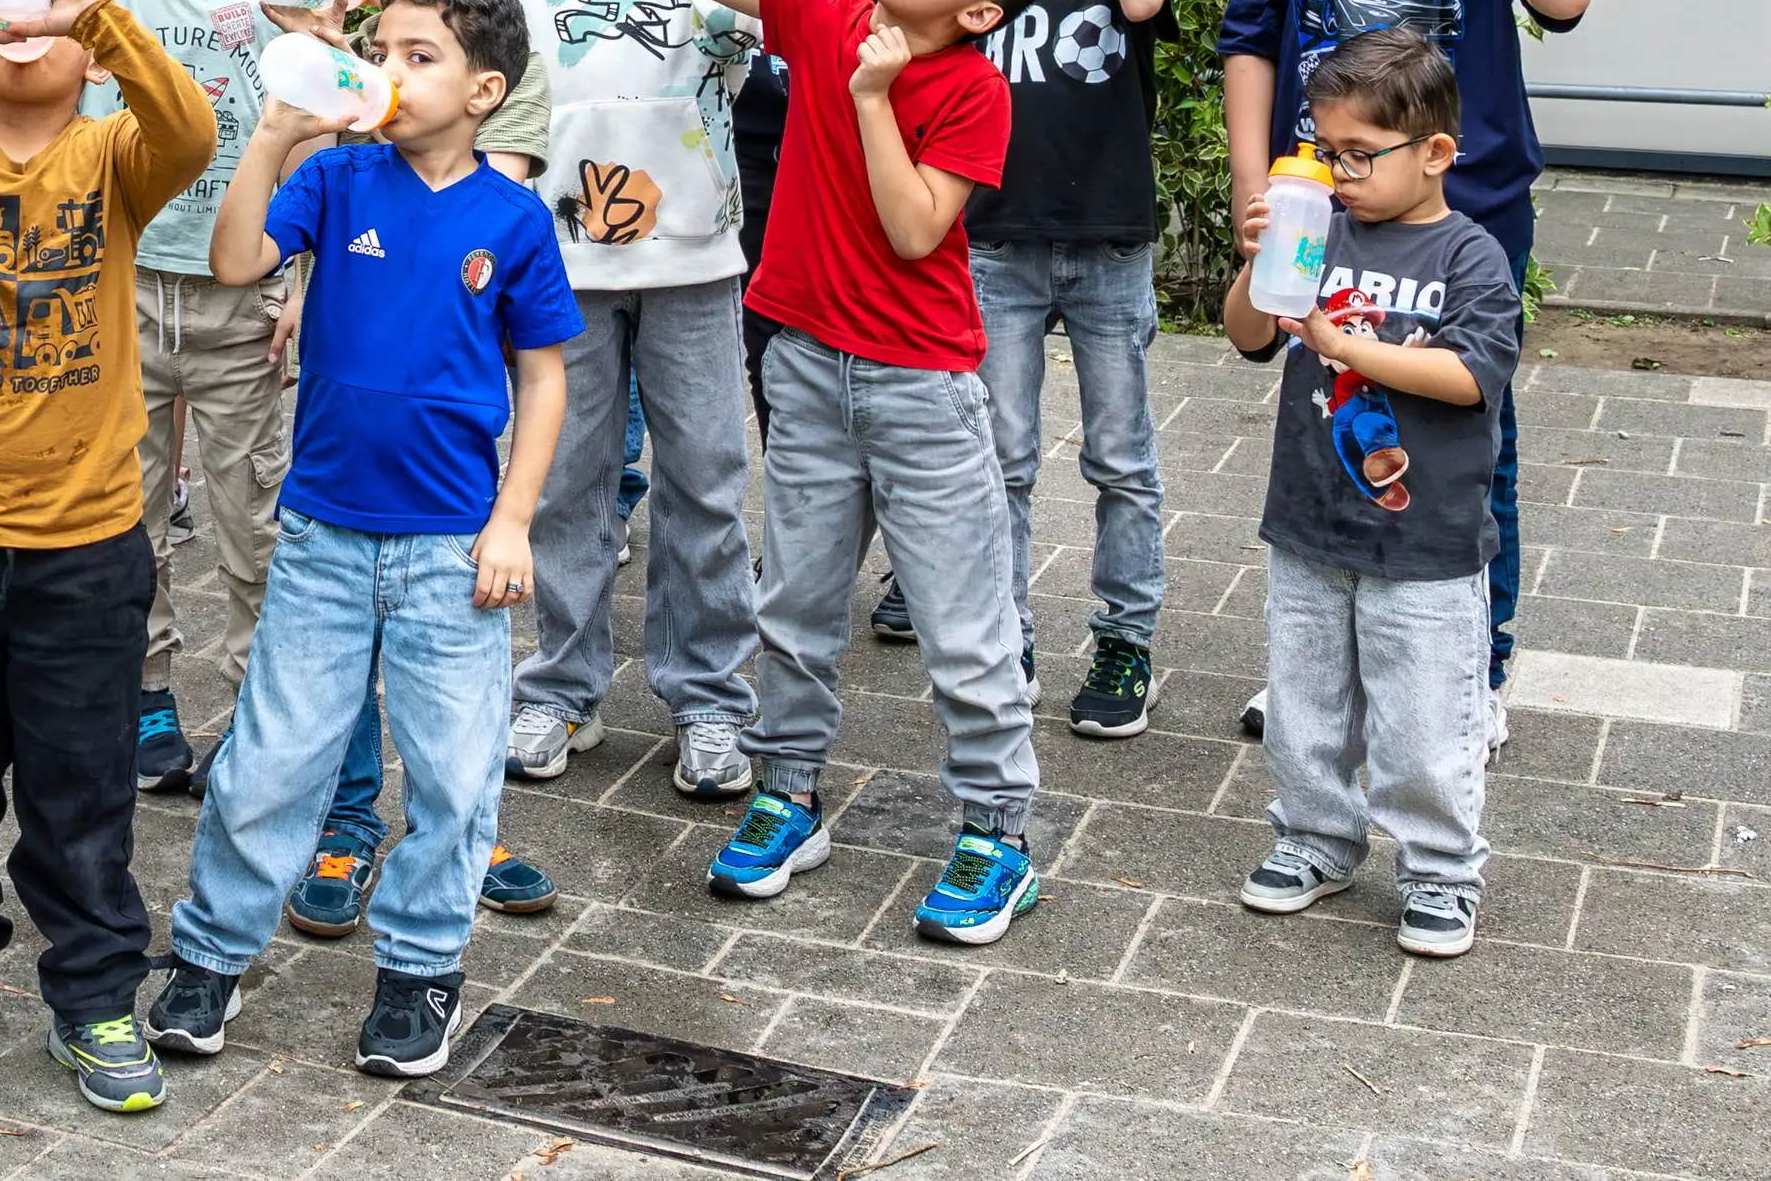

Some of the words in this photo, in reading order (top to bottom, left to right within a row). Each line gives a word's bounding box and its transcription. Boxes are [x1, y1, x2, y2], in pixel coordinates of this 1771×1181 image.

[217, 8, 247, 23] BUILD
[348, 242, 386, 258] adidas
[1319, 265, 1447, 319] ARIO
[11, 364, 101, 394] TOGETHER
